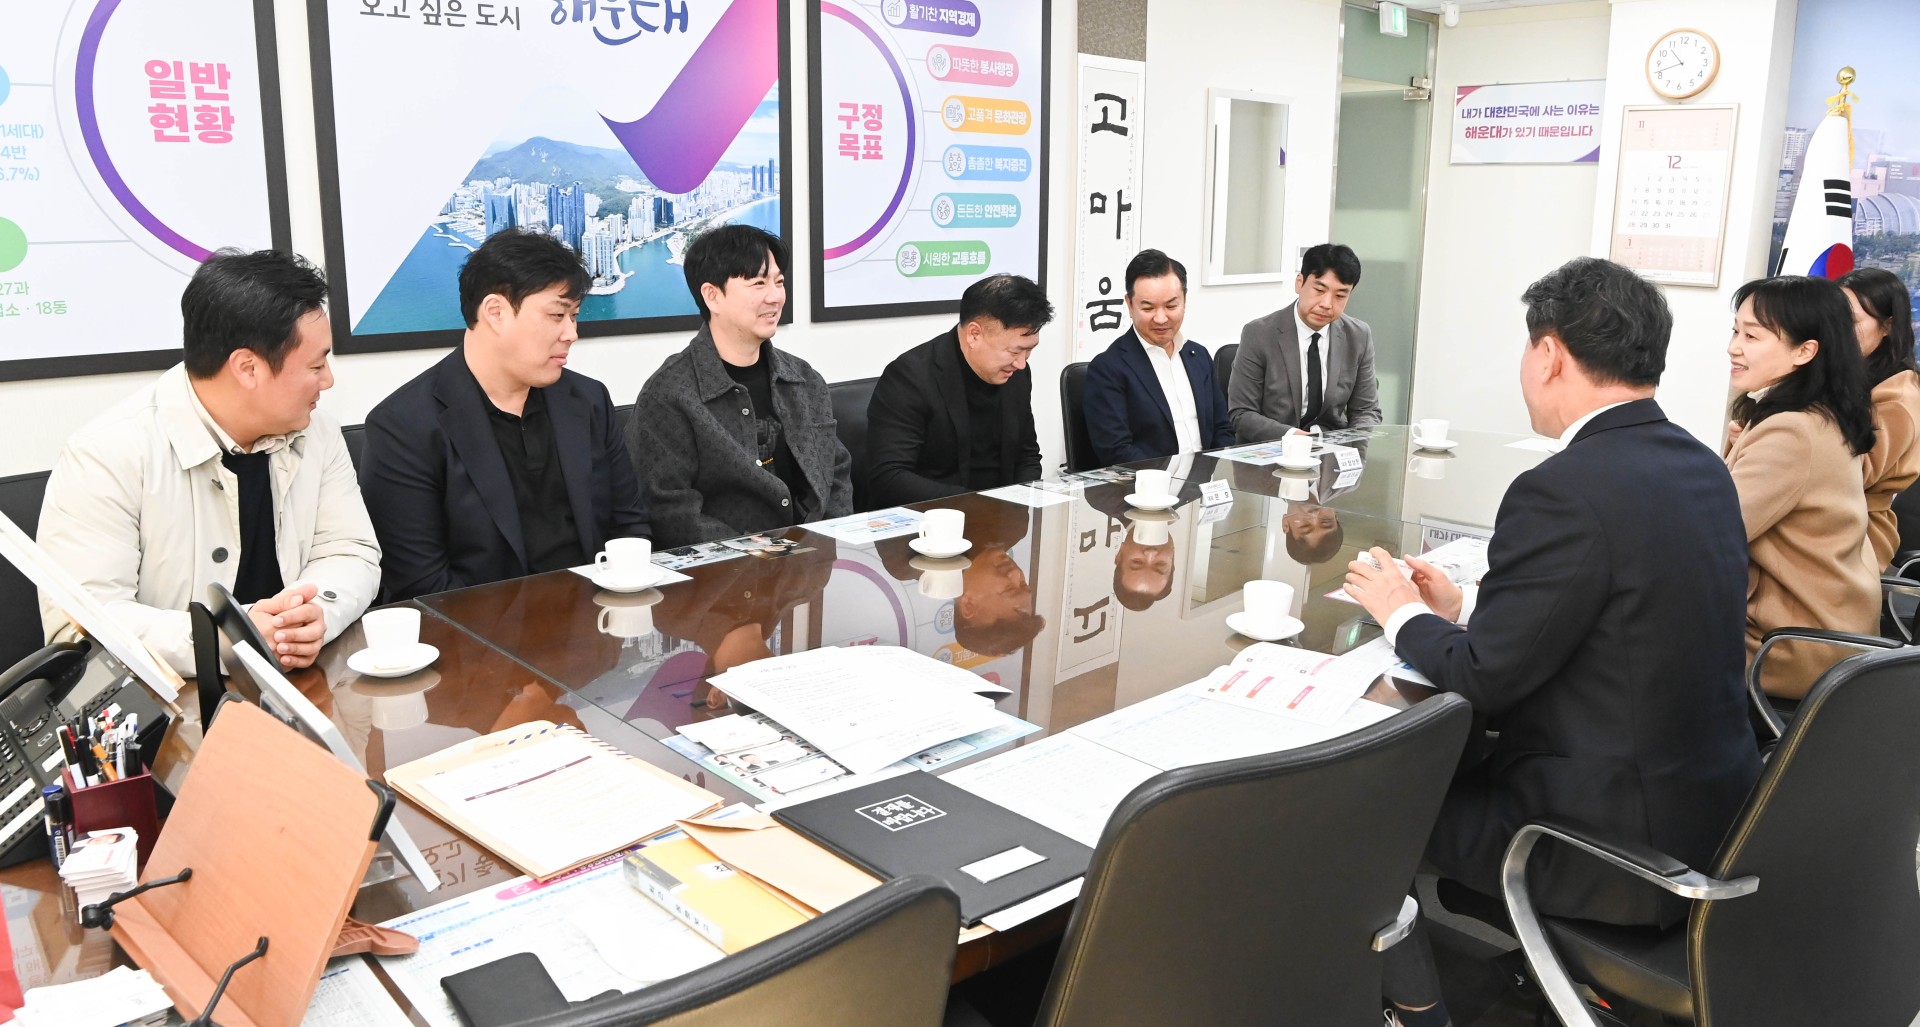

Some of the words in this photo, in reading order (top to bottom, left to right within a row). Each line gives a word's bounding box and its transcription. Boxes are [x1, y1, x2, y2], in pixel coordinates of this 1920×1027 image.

[419, 0, 467, 28] 싶은
[475, 4, 520, 30] 도시
[909, 4, 938, 21] 활기찬
[939, 8, 976, 28] 지역경제
[1680, 36, 1689, 44] 12
[1701, 46, 1706, 54] 2
[952, 57, 979, 74] 따뜻한
[981, 61, 1014, 78] 봉사행정
[1703, 58, 1708, 67] 3
[144, 60, 231, 101] 일반
[1697, 70, 1703, 78] 4
[1677, 82, 1681, 90] 6
[1690, 79, 1695, 87] 5
[838, 102, 883, 131] 구정
[967, 108, 993, 123] 고품격
[995, 110, 1026, 125] 문화관광
[1461, 108, 1482, 119] 내가
[1484, 105, 1540, 118] 대한민국에
[1542, 105, 1564, 116] 사는
[1567, 103, 1600, 115] 이유는
[148, 103, 235, 144] 현황
[1465, 125, 1513, 139] 해운대가
[1515, 126, 1535, 138] 있기
[1538, 125, 1593, 138] 때문입니다
[838, 133, 883, 161] 목표
[968, 156, 994, 171] 촘촘한
[995, 158, 1026, 172] 복지증진
[1667, 155, 1682, 169] 12
[957, 204, 983, 218] 든든한
[985, 204, 1016, 218] 안전확보
[1086, 92, 1132, 332] 고마움
[923, 252, 950, 267] 시원한
[952, 251, 986, 265] 교통흐름
[36, 300, 68, 315] 18동
[871, 800, 915, 817] 결재를
[882, 806, 936, 826] 바랍니다
